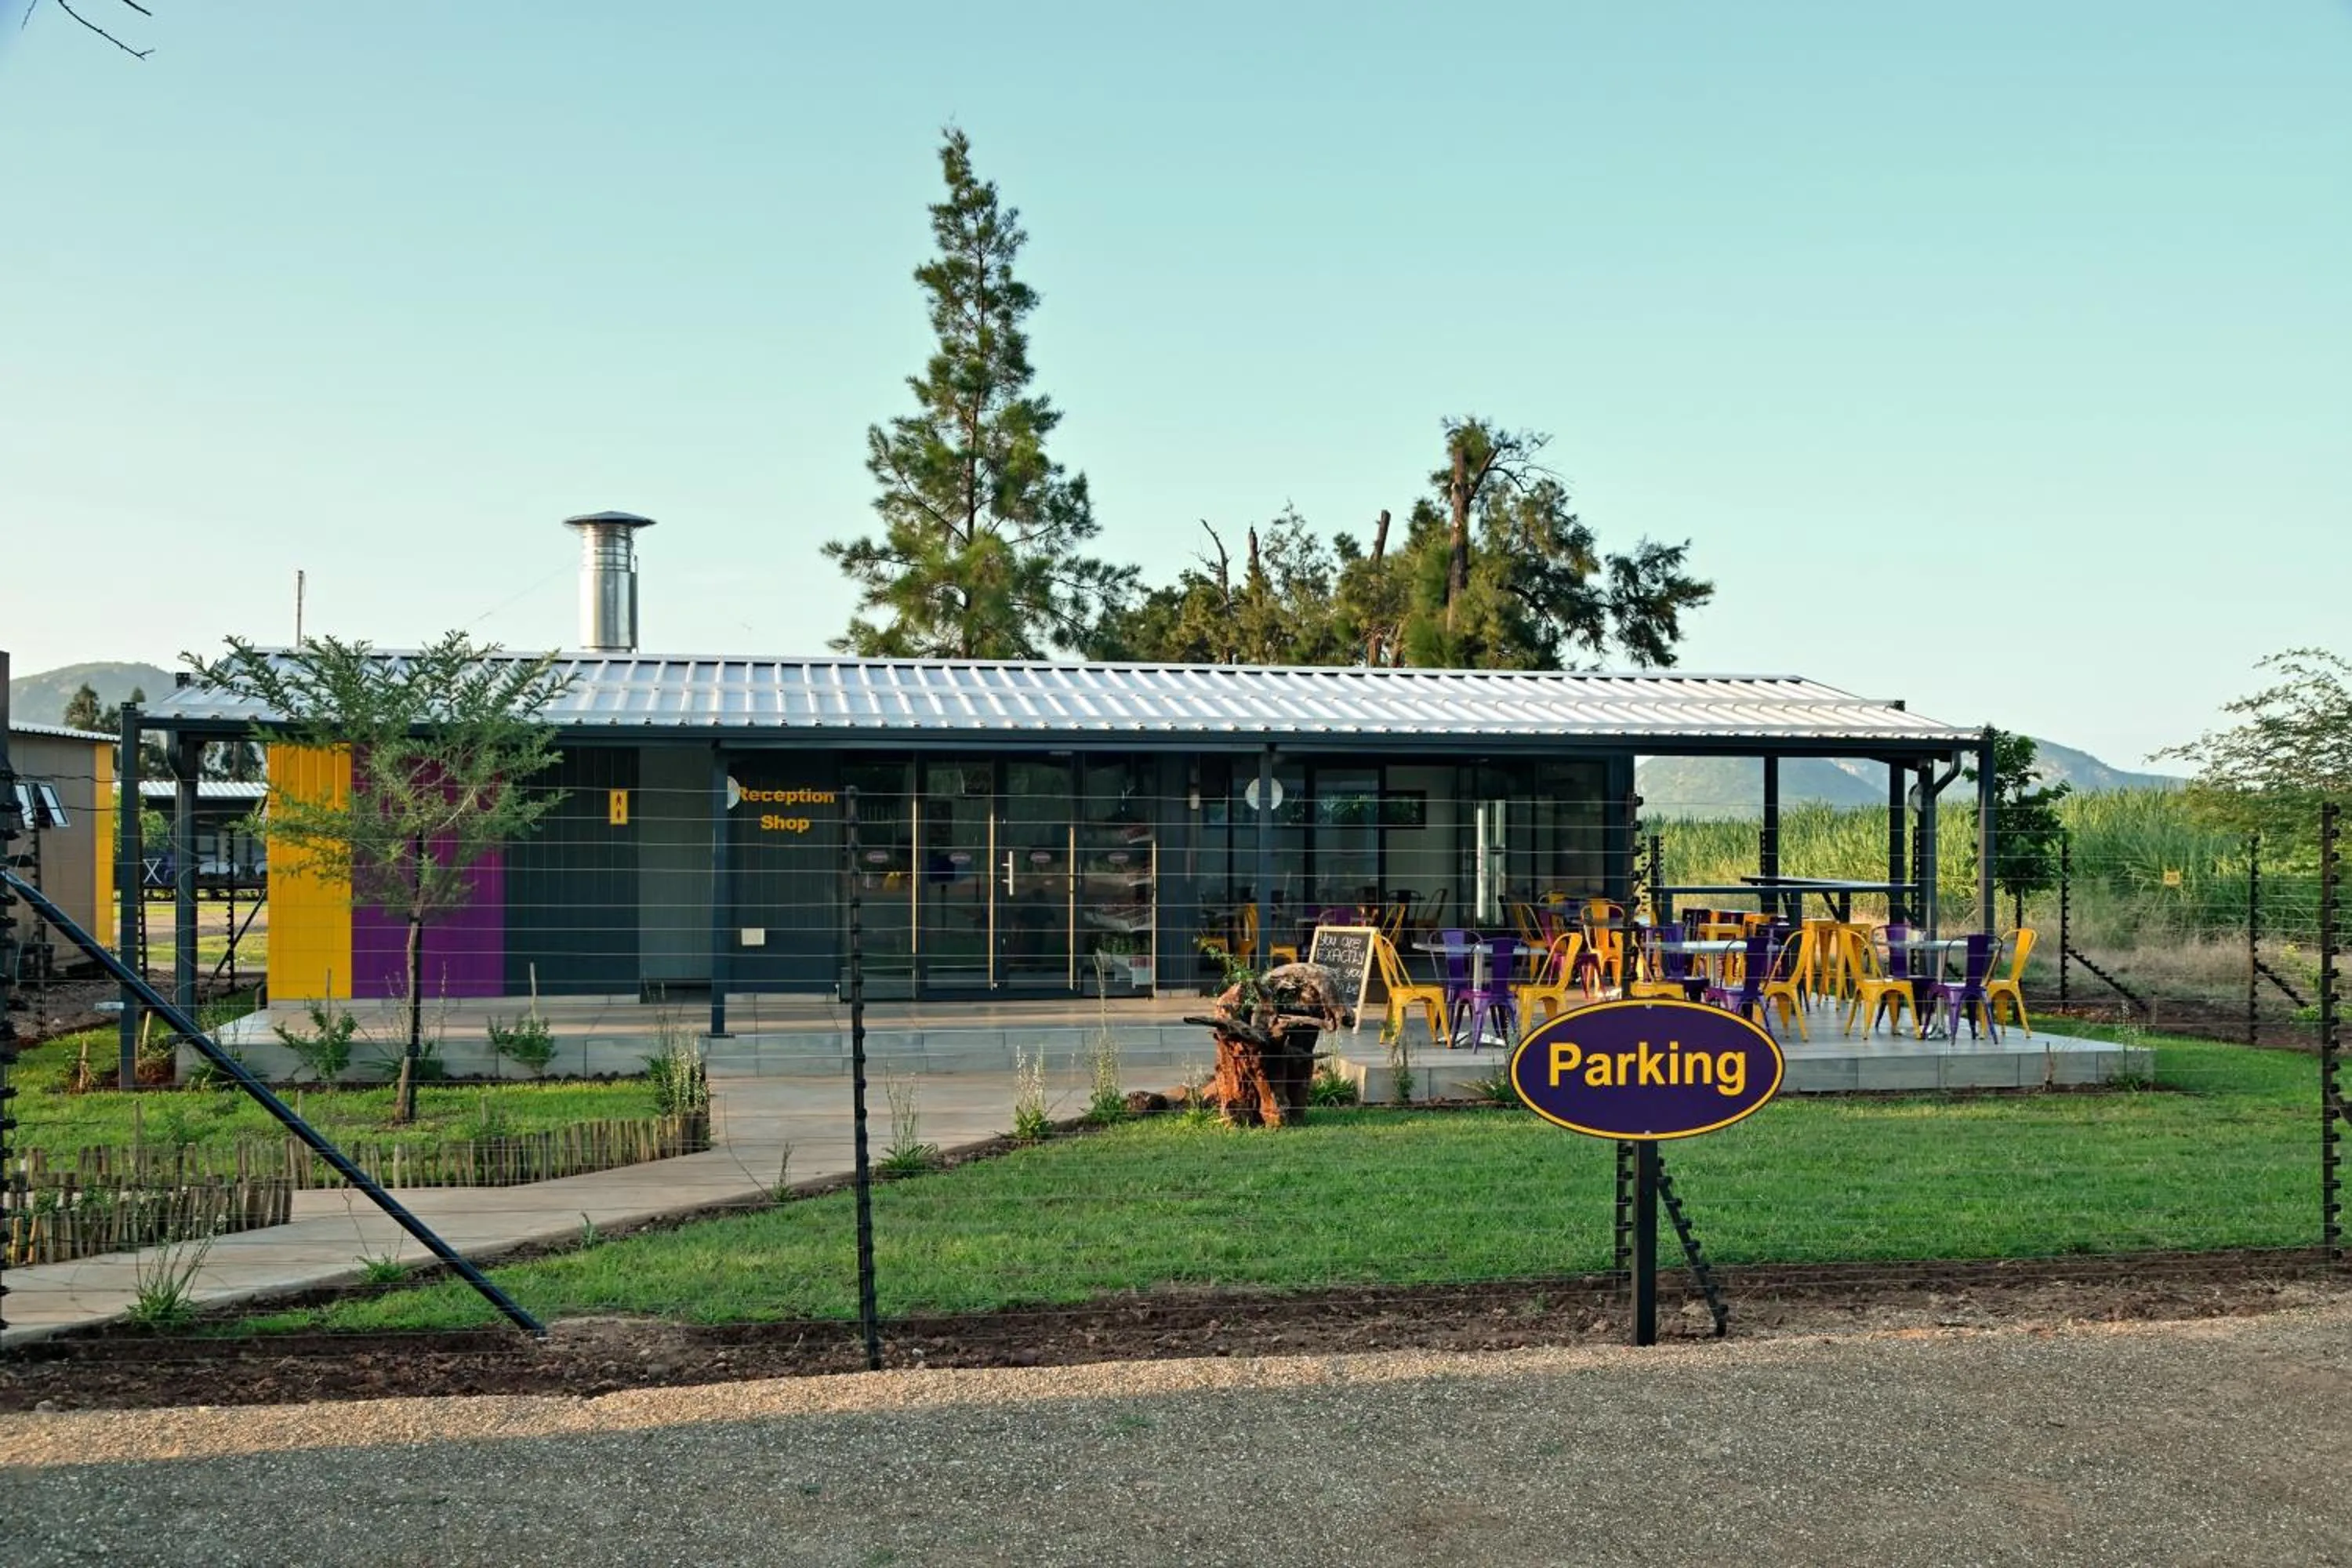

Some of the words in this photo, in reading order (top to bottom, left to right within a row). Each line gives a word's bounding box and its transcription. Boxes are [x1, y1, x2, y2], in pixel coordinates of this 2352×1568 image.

[739, 786, 836, 805] Reception
[760, 815, 810, 833] Shop
[1549, 1041, 1746, 1096] Parking
